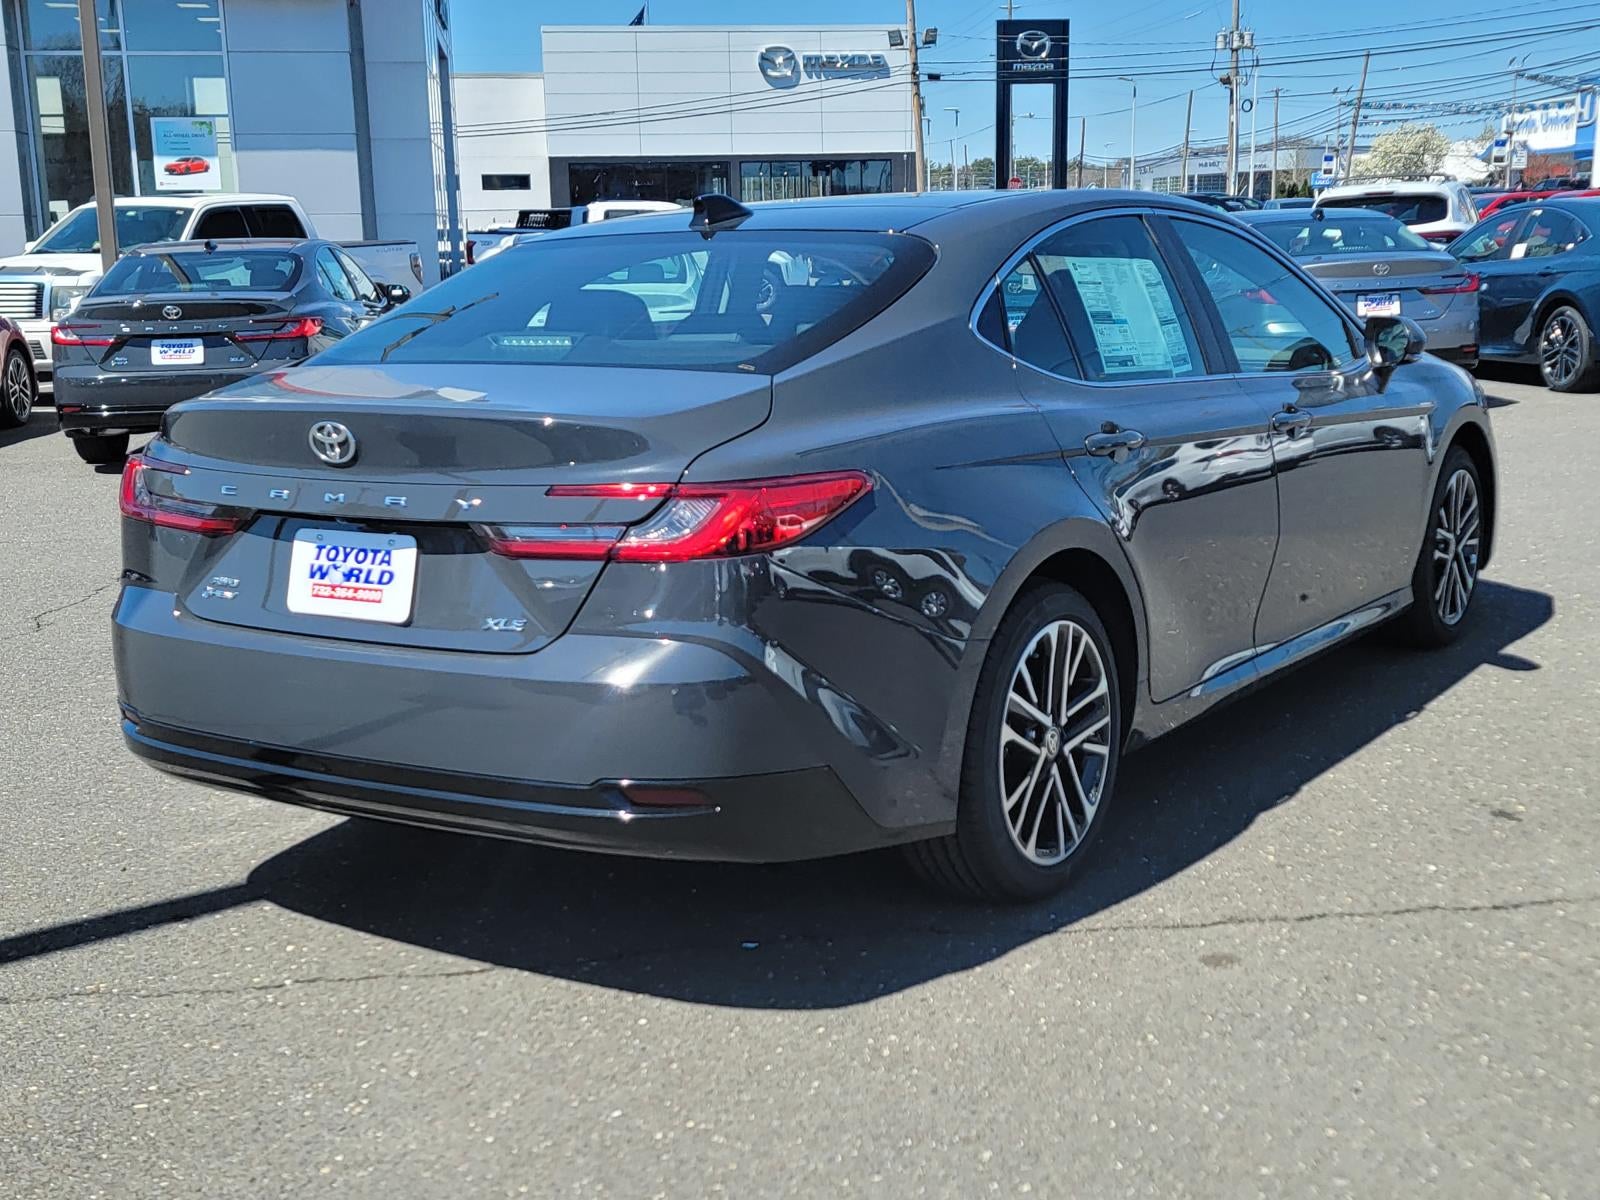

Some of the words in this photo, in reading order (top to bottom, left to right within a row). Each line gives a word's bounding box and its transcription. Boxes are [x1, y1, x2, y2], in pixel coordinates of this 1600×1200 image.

[220, 484, 482, 511] CAMRY
[315, 544, 393, 567] TOYOTA
[309, 563, 395, 586] WORLD
[481, 617, 527, 631] XLE
